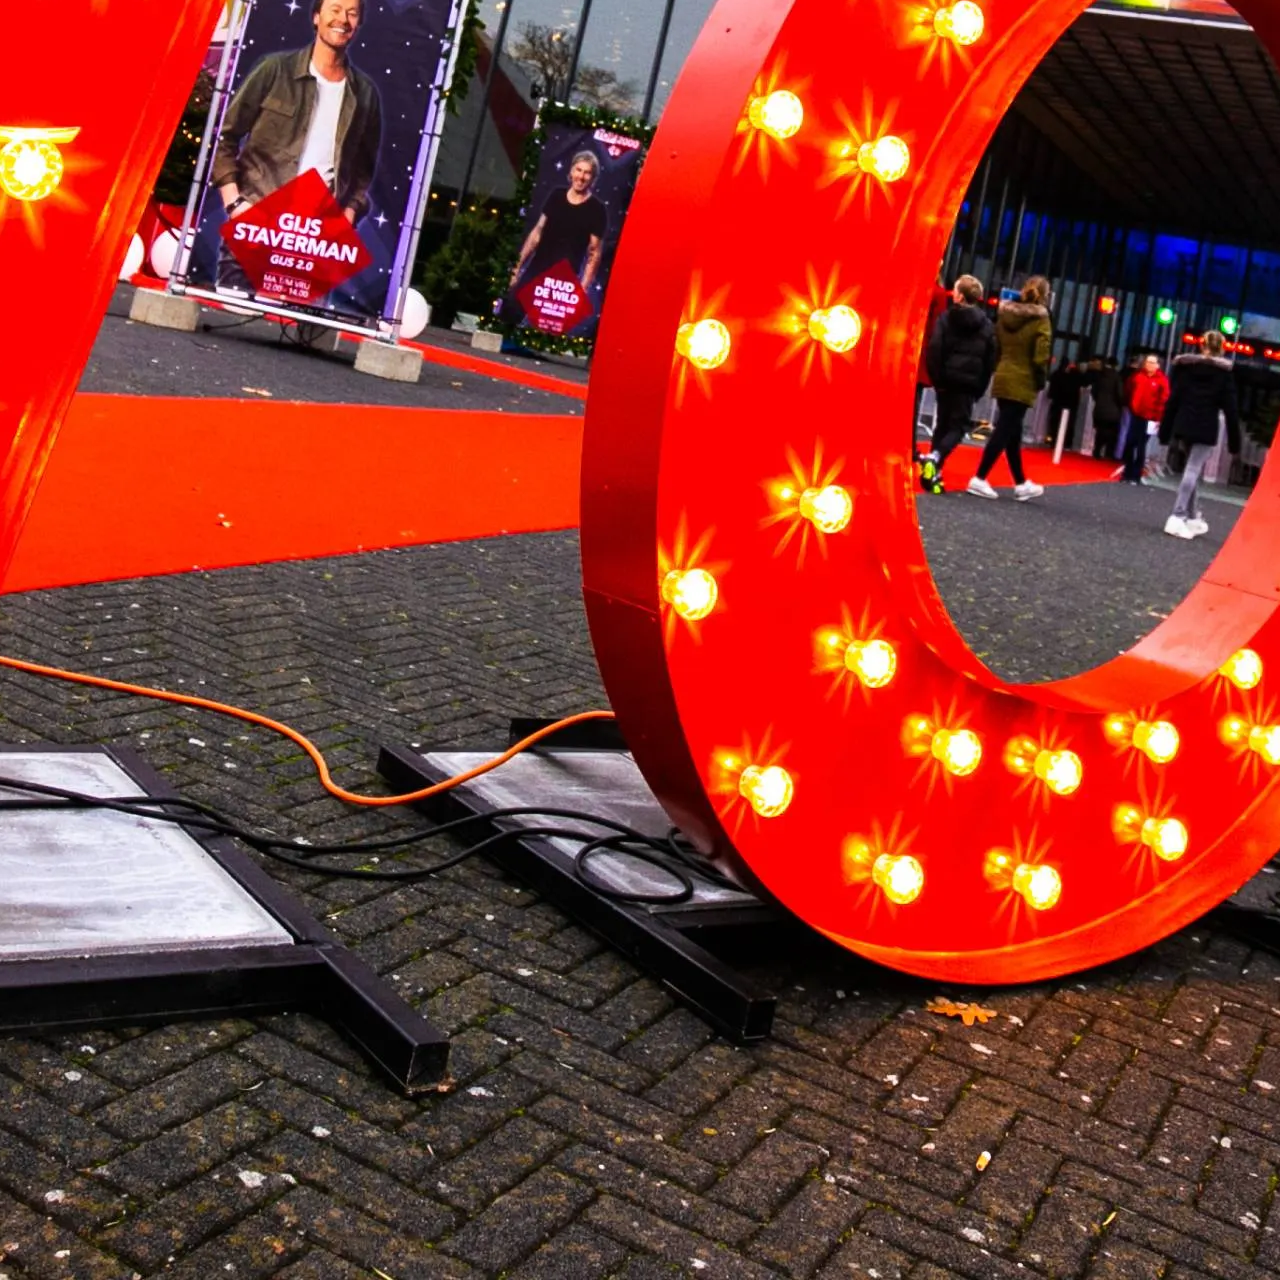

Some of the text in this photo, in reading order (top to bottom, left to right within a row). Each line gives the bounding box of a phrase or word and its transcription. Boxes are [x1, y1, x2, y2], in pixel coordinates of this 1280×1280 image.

[278, 212, 323, 237] GIJS
[233, 222, 359, 264] STAVERMAN
[270, 254, 315, 272] GIJS 2.0
[534, 285, 580, 306] DE WILD
[544, 276, 576, 294] RUUD
